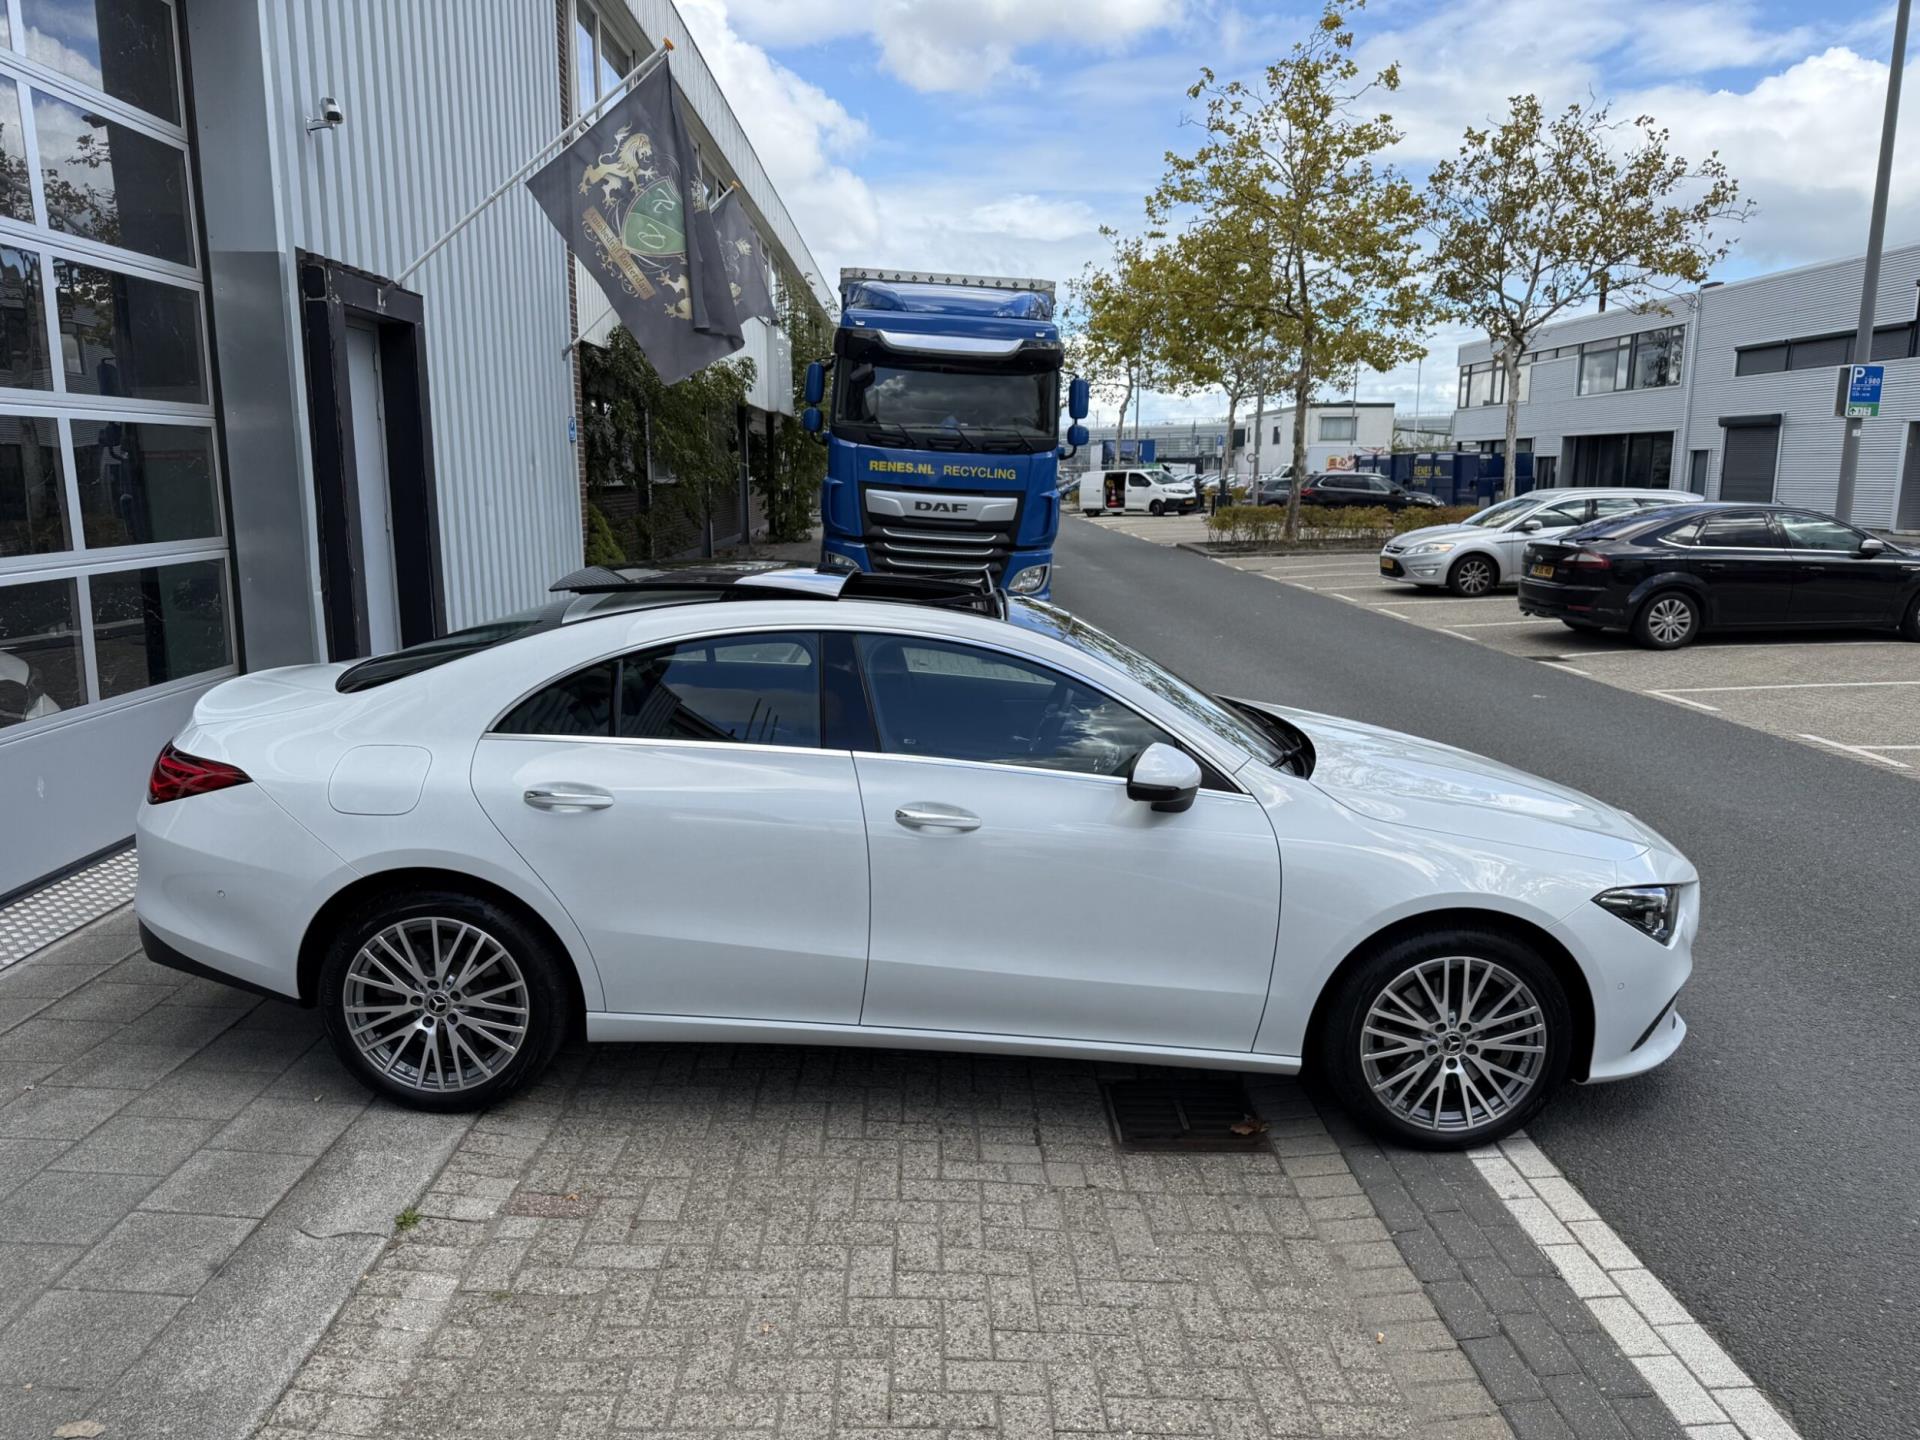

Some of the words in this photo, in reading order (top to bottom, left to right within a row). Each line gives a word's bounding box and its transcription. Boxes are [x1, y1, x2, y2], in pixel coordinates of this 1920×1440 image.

[1853, 367, 1866, 383] P
[869, 459, 935, 475] RENES.NL
[943, 465, 1016, 480] RECYCLING
[914, 501, 968, 513] DAF
